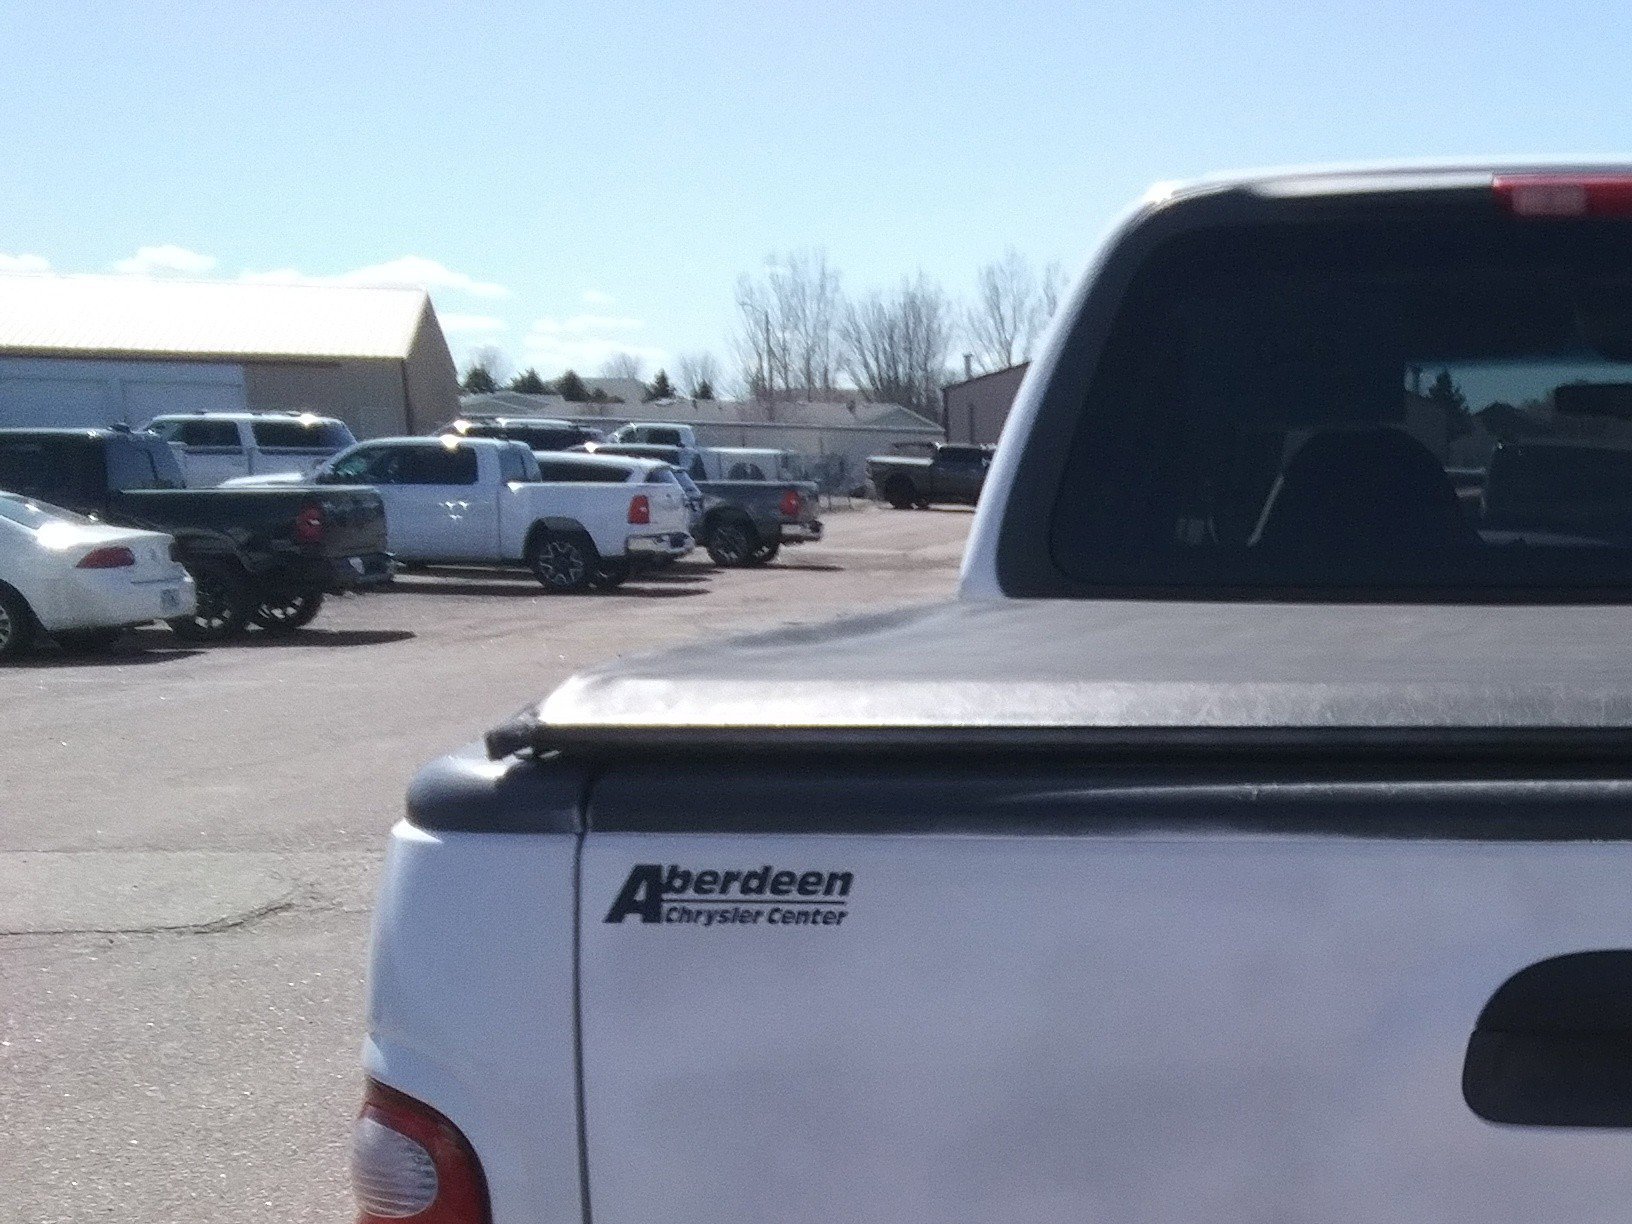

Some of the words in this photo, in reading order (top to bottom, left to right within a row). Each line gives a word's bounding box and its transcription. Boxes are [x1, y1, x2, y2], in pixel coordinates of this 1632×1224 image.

[602, 863, 854, 925] Aberdeen
[665, 906, 760, 926] Chrysler
[766, 906, 848, 926] Center
